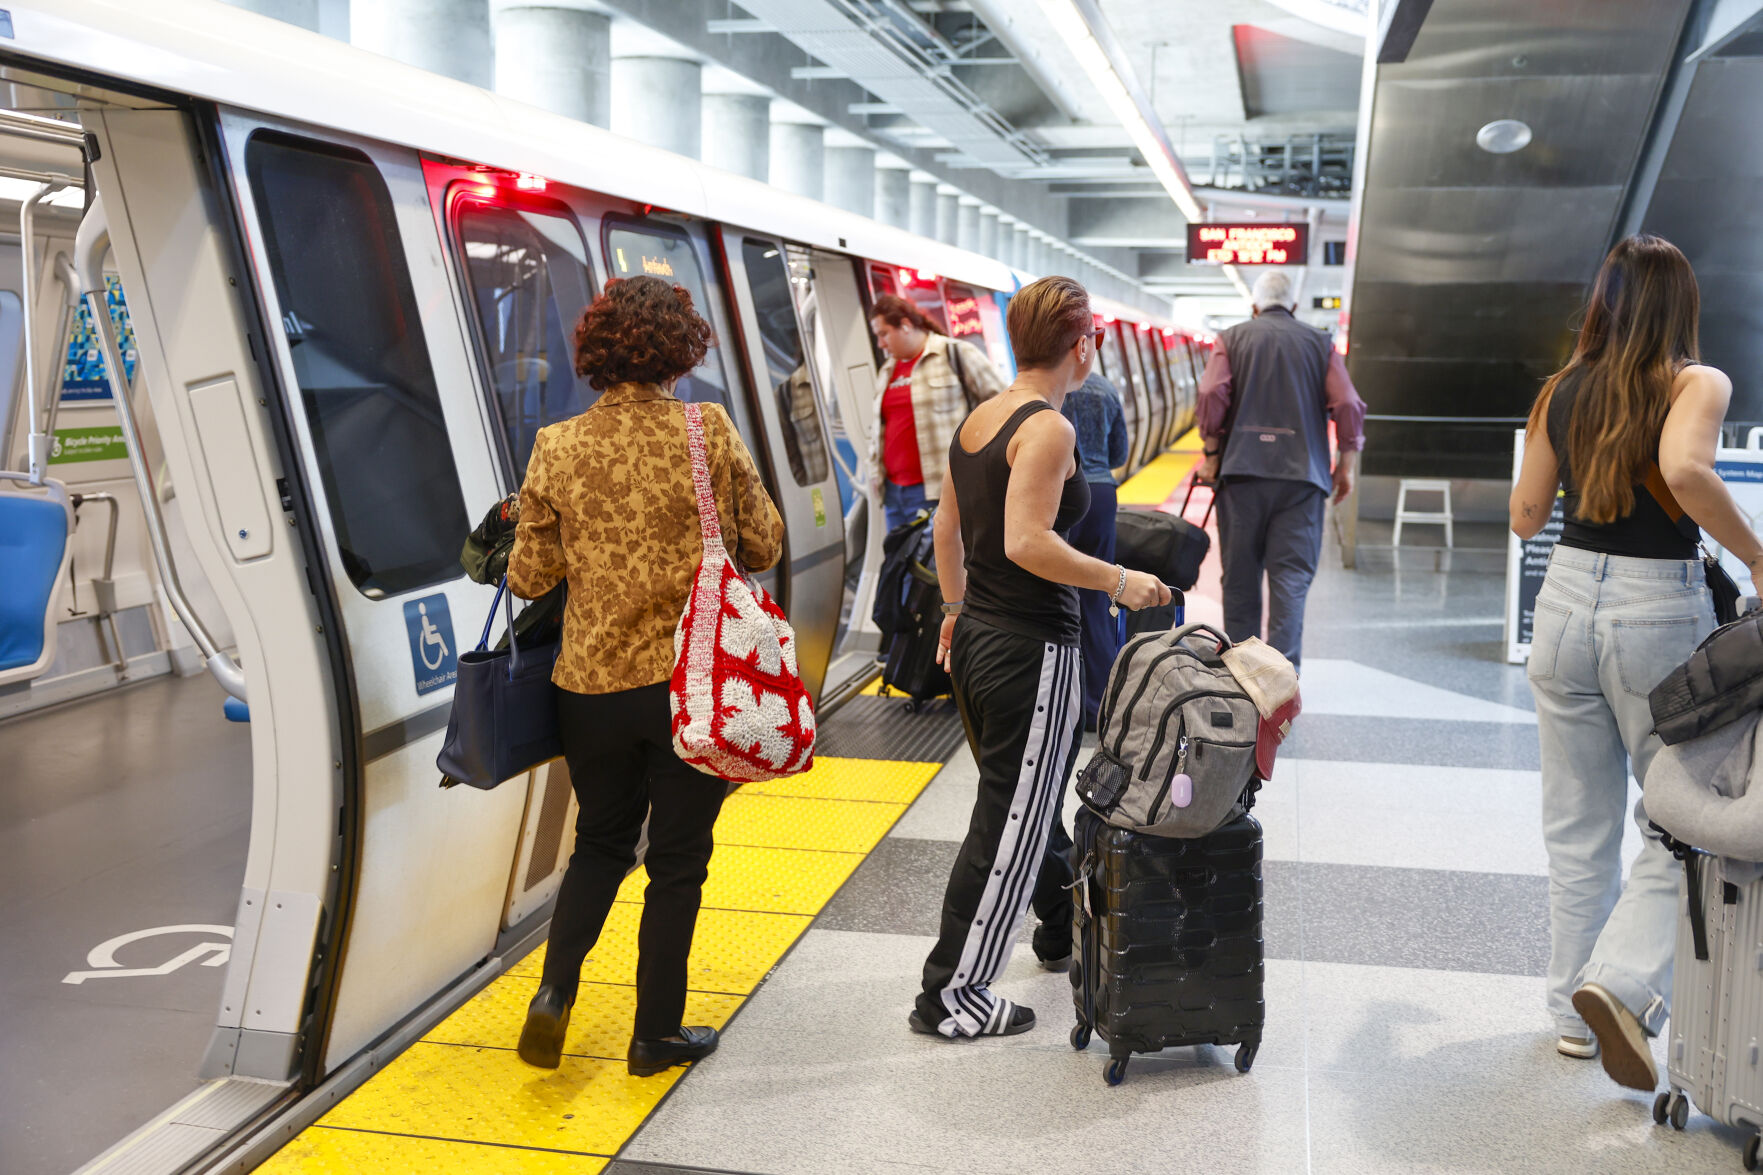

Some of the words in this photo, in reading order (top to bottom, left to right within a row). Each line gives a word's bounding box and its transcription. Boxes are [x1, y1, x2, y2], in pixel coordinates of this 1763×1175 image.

[1199, 227, 1226, 241] SAN
[1228, 227, 1296, 242] FRANCISCO
[1718, 469, 1744, 478] System
[417, 674, 446, 689] Wheelchair
